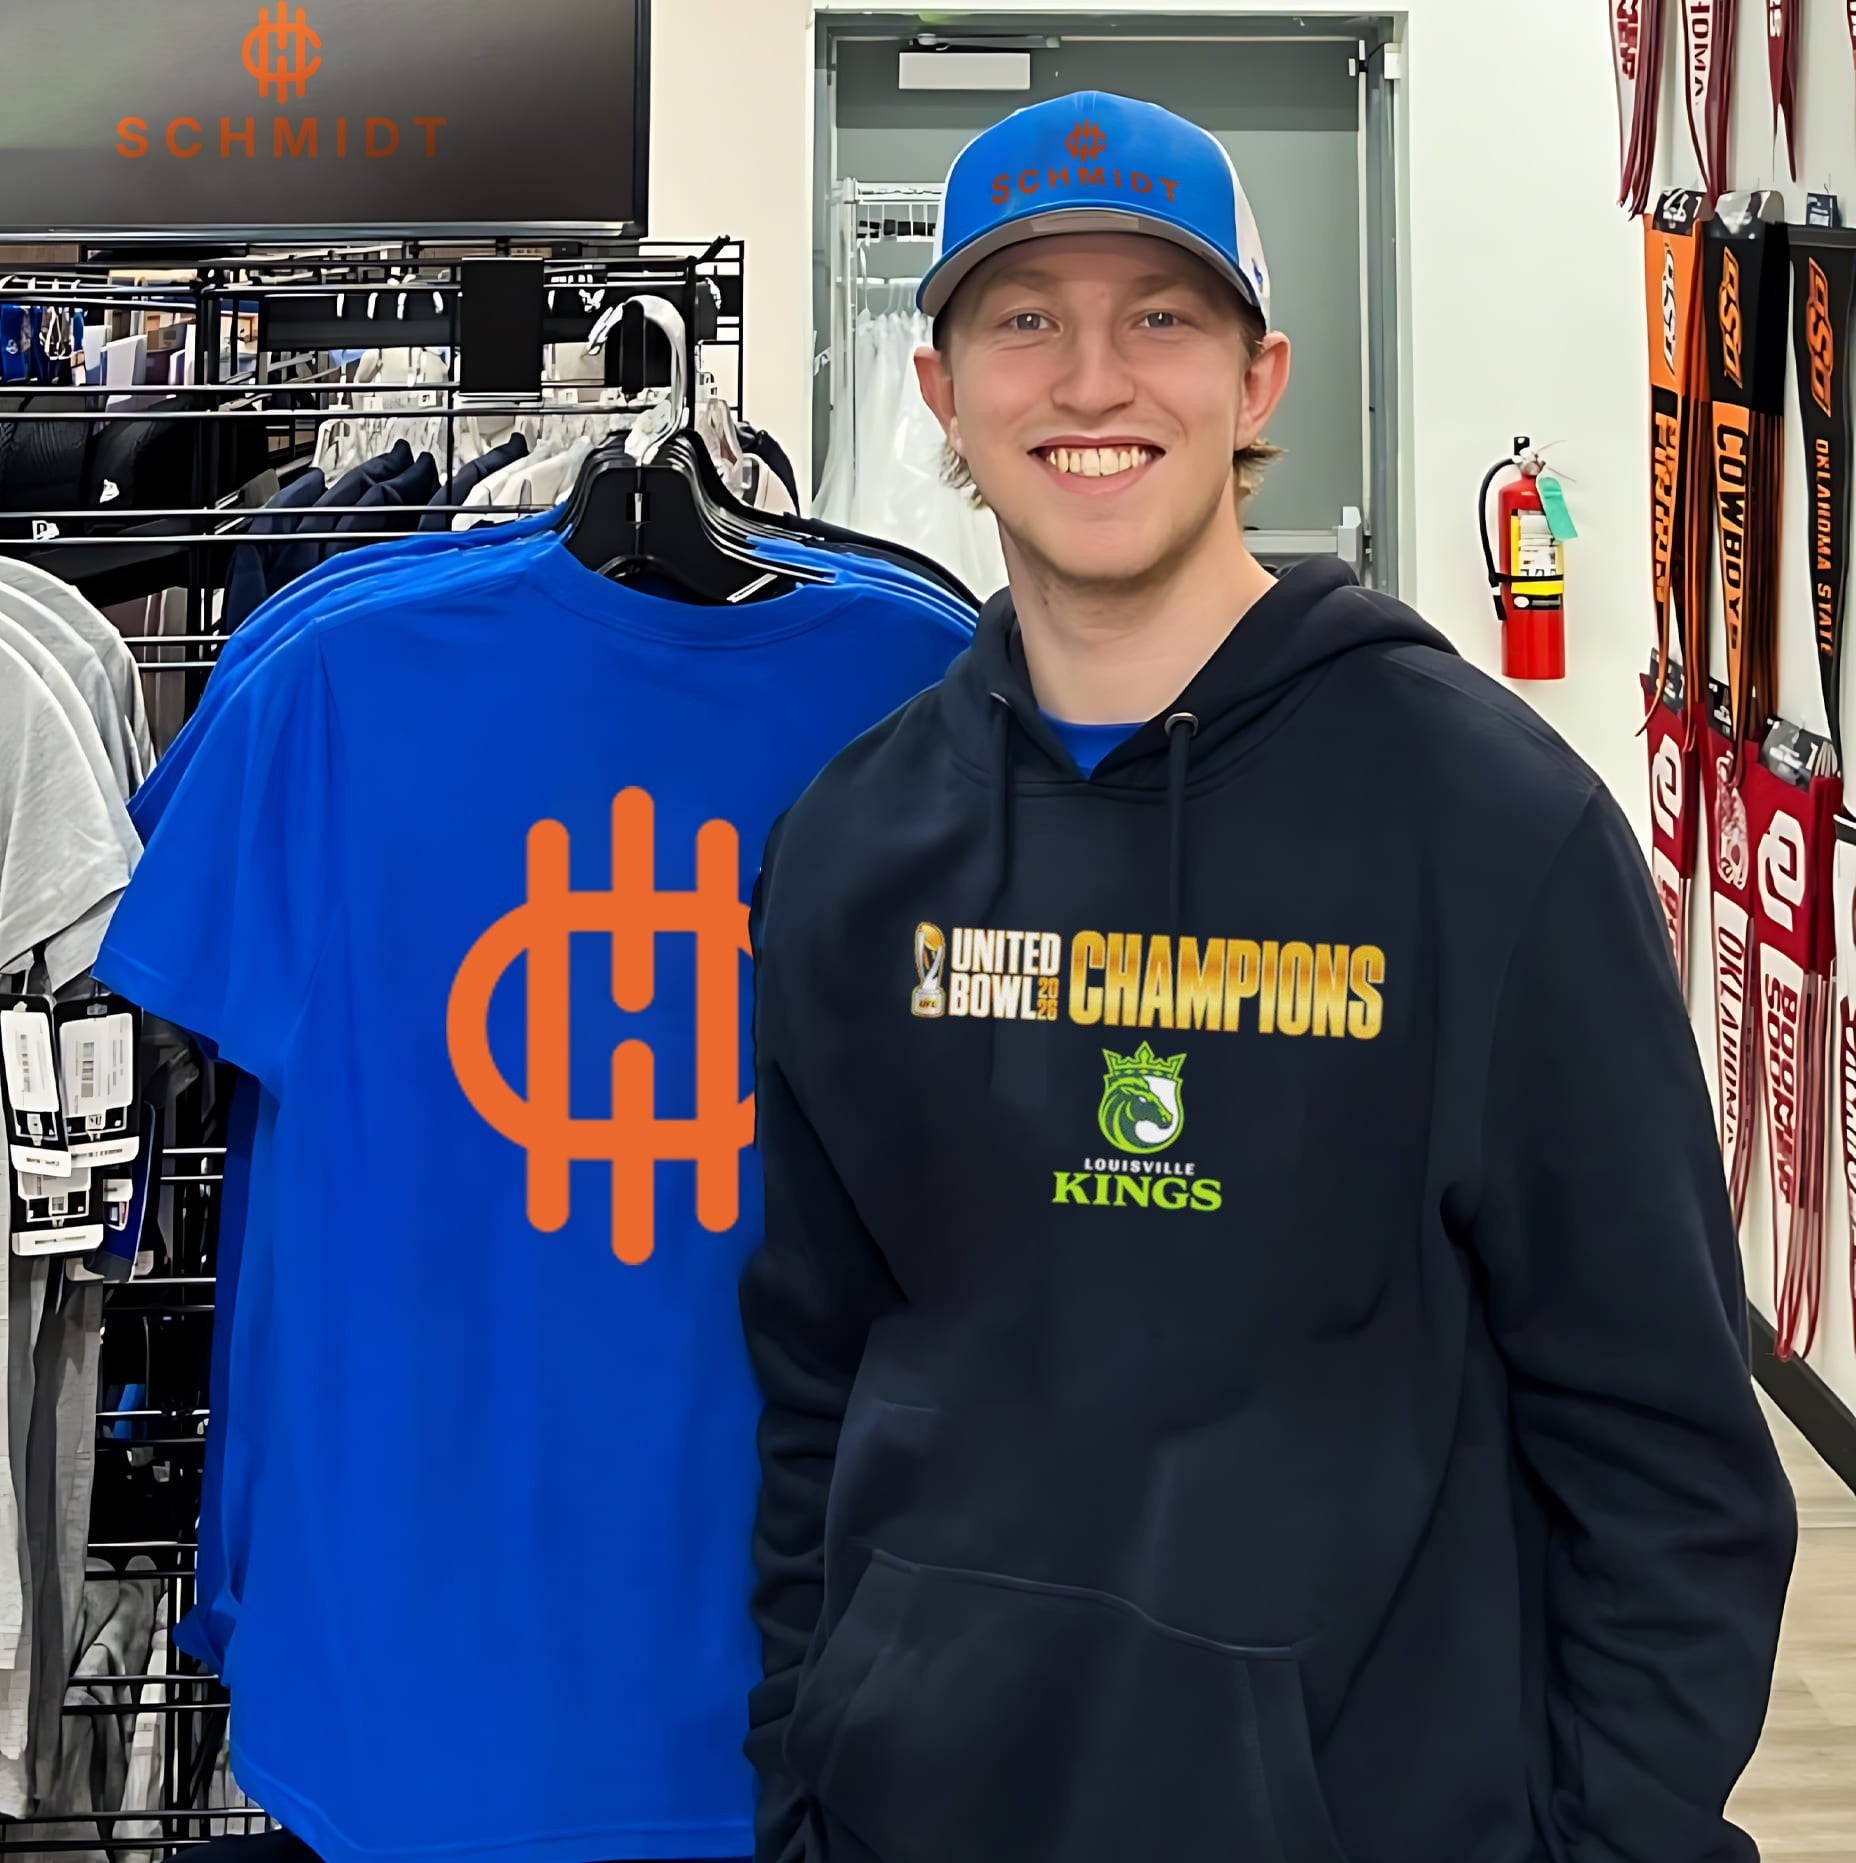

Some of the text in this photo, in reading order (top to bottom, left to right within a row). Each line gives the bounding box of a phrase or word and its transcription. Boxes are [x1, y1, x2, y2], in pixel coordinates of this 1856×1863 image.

[116, 117, 447, 158] SCHMIDT
[991, 167, 1179, 204] SCHMIDT
[1815, 438, 1832, 571] OKLAHOMA
[950, 927, 1062, 976] UNITED
[948, 971, 1037, 1020] BOWL
[1068, 930, 1386, 1040] CHAMPIONS
[1084, 1158, 1196, 1176] LOUISVILLE
[1051, 1171, 1222, 1212] KINGS
